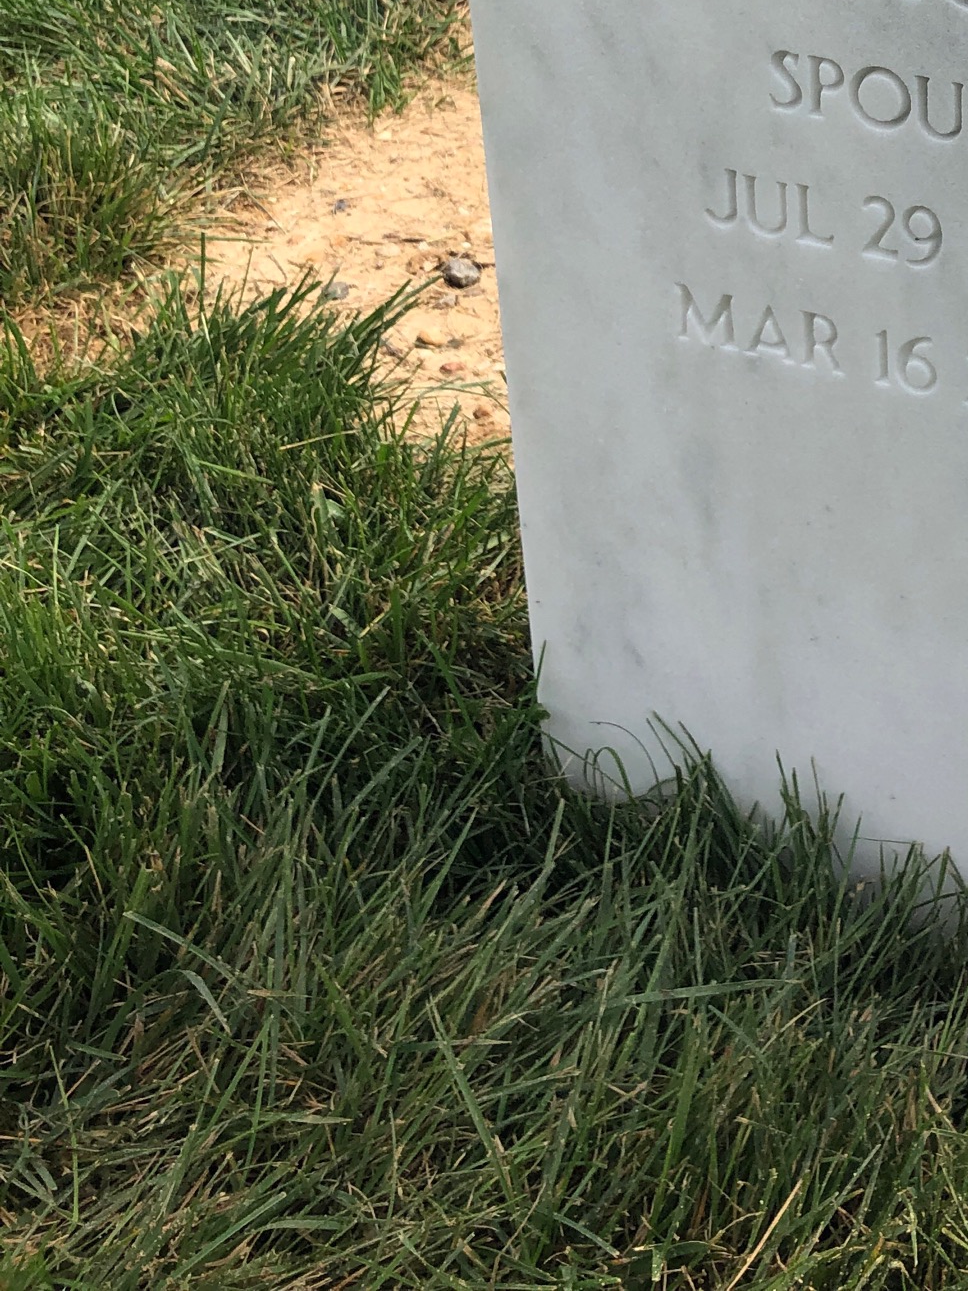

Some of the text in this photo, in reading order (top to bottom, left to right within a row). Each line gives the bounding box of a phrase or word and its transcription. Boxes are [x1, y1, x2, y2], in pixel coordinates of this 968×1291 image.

[704, 167, 834, 248] JUL
[861, 195, 943, 269] 29
[673, 281, 845, 378] MAR
[873, 329, 938, 395] 16
